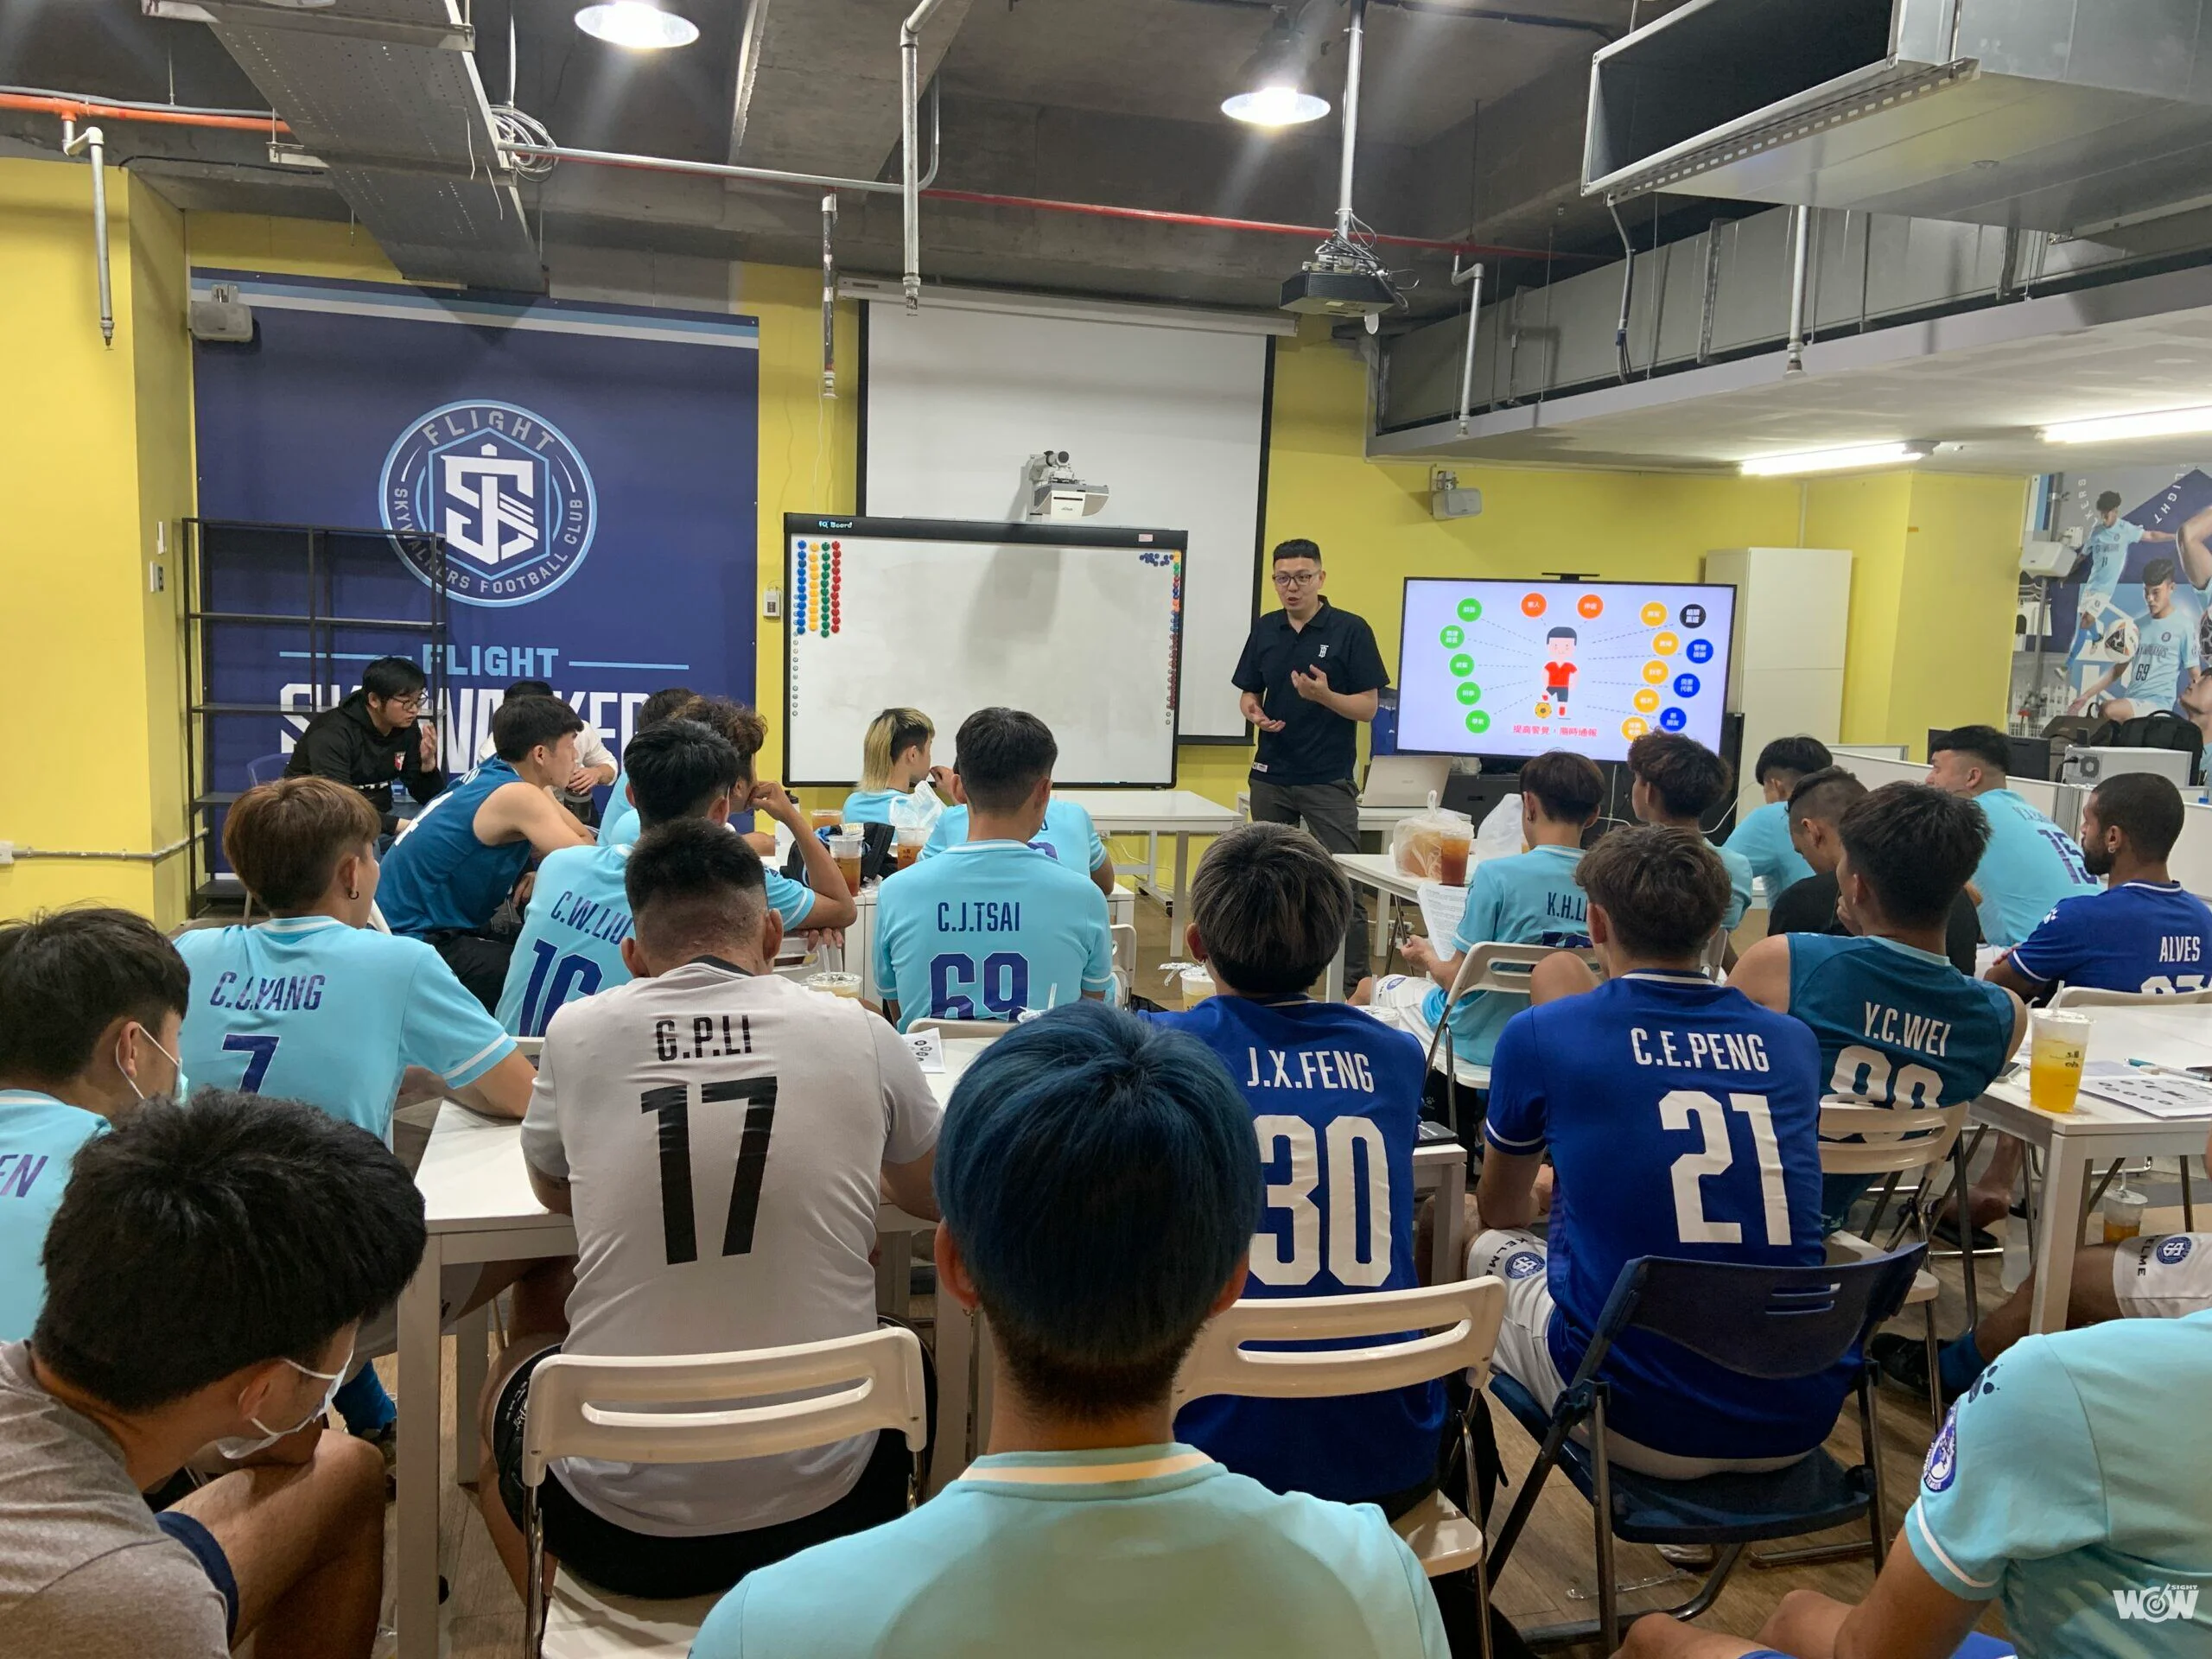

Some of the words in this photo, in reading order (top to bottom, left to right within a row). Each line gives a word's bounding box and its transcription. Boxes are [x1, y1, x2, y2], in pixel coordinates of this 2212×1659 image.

[423, 410, 555, 452] FLIGHT
[2154, 463, 2186, 524] LIGHT
[480, 552, 569, 594] FOOTBALL
[563, 499, 583, 545] CLUB
[422, 644, 560, 678] FLIGHT
[550, 891, 632, 945] C.W.LIU
[938, 902, 1020, 931] C.J.TSAI
[2159, 937, 2201, 963] ALVES
[931, 951, 1030, 1022] 69
[656, 1014, 753, 1062] G.P.LI
[1630, 1027, 1770, 1072] C.E.PENG
[1864, 1001, 1951, 1058] Y.C.WEI
[221, 1033, 281, 1095] 7
[1247, 1046, 1375, 1093] J.X.FENG
[641, 1076, 779, 1265] 17
[1658, 1090, 1792, 1246] 21
[1249, 1115, 1393, 1287] 30
[1485, 1237, 1529, 1276] KELME
[2138, 1235, 2160, 1276] ELME
